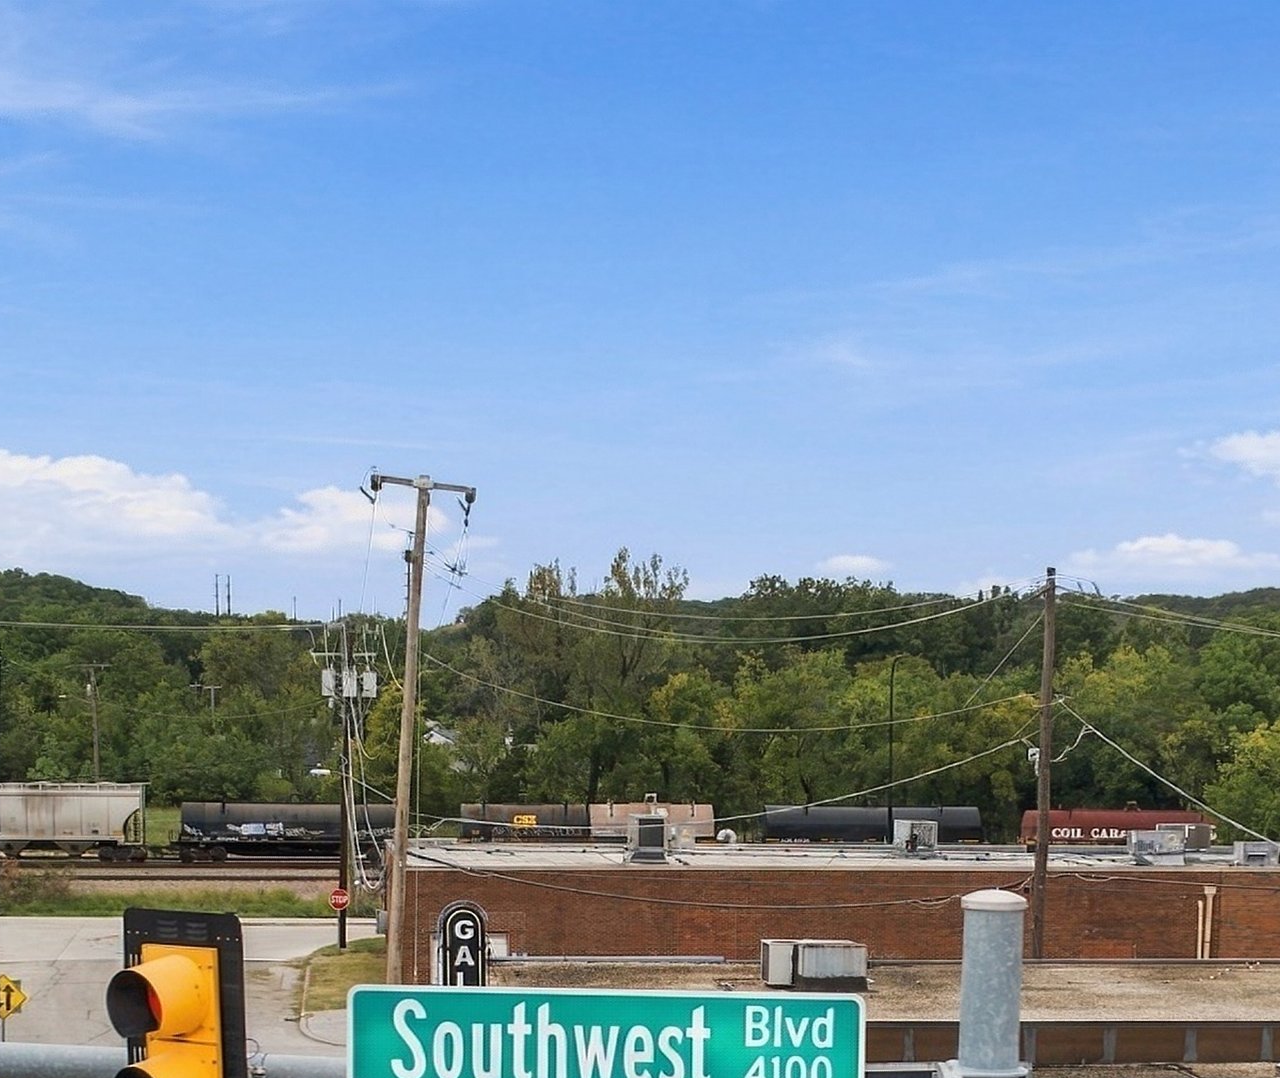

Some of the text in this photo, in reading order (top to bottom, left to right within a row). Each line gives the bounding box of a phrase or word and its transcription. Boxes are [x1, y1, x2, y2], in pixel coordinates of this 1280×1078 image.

[513, 814, 537, 826] CSX
[1051, 827, 1084, 839] COIL
[331, 895, 349, 904] STOP
[745, 1005, 834, 1048] Blvd
